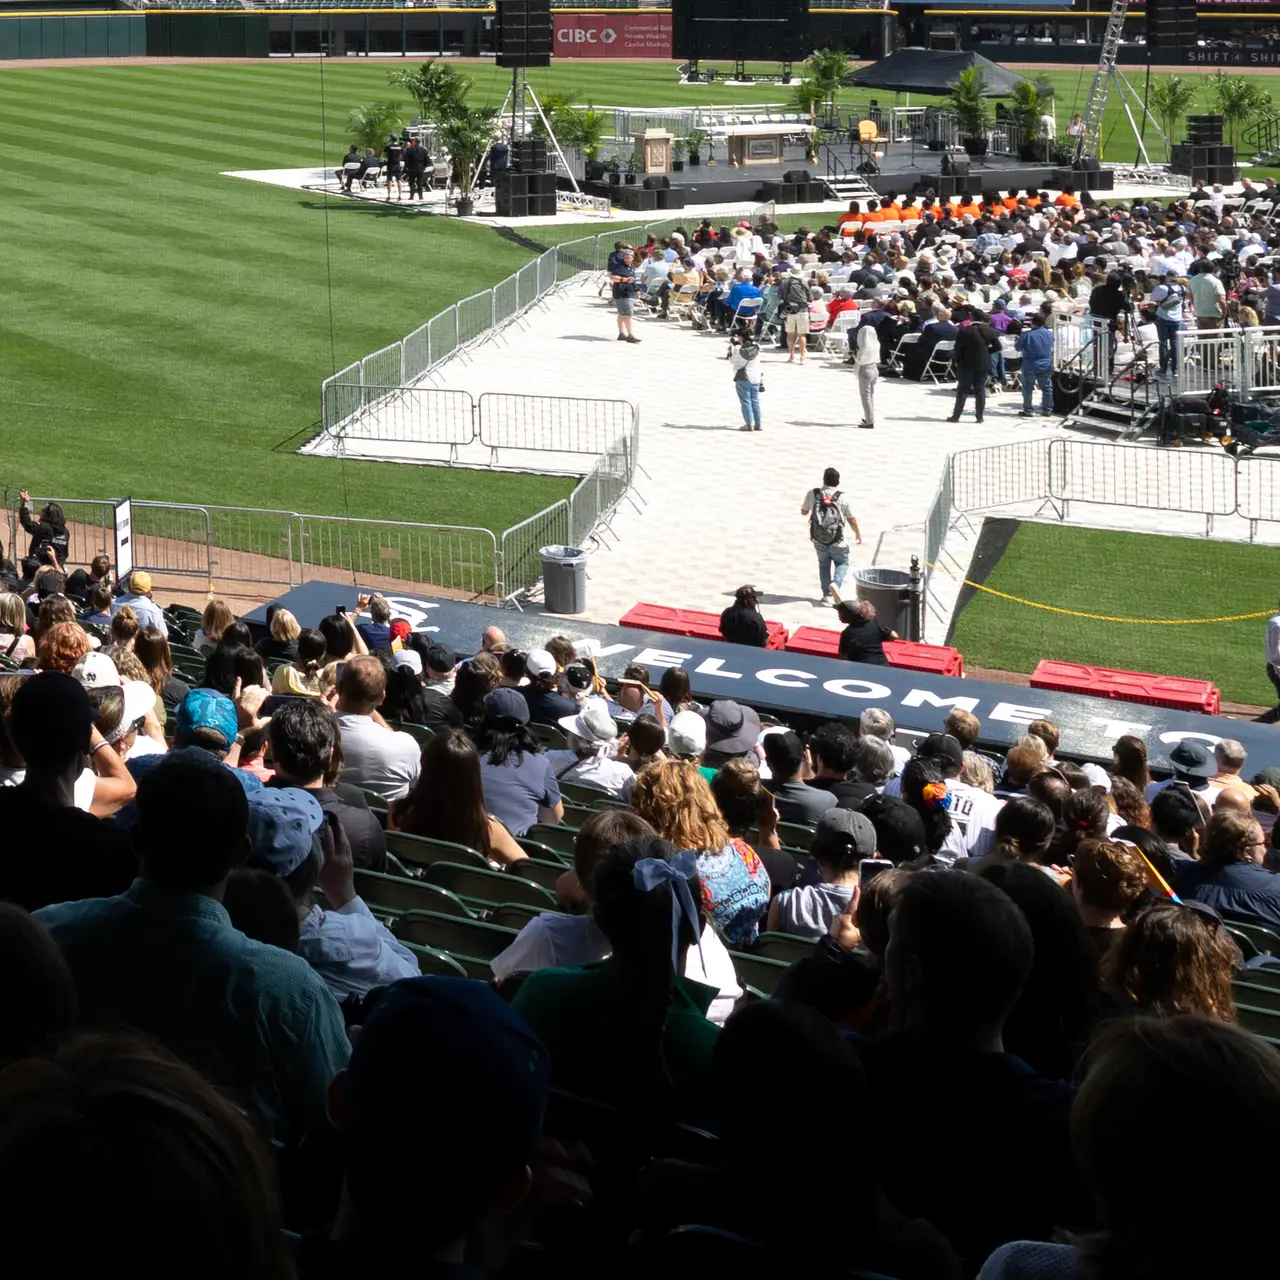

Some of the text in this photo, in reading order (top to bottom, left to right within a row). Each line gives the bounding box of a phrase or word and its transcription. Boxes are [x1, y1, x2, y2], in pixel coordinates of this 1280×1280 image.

[557, 28, 598, 44] CIBC
[1188, 52, 1229, 61] SHIFT
[571, 637, 1052, 725] WELCOME
